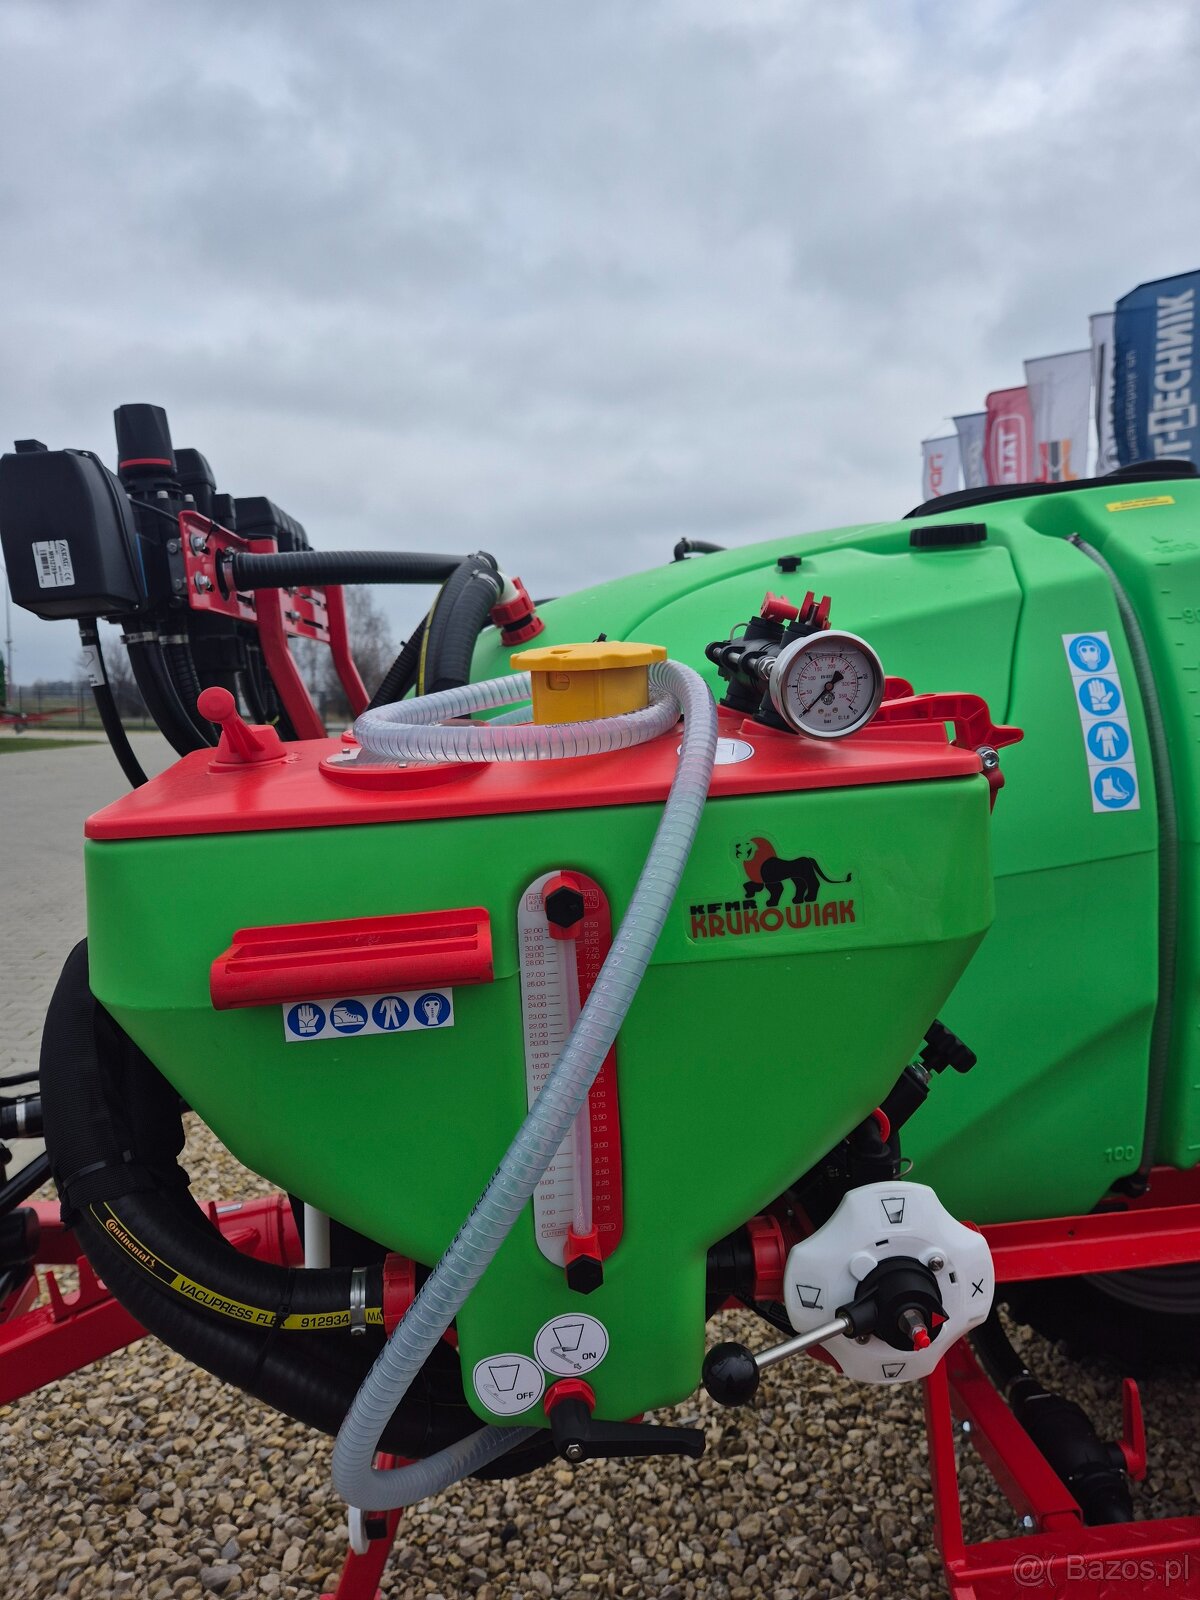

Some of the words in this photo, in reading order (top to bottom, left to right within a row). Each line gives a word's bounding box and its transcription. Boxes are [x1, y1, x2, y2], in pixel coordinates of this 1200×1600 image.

[690, 899, 758, 915] KFMR
[691, 899, 856, 939] KRUKOWIAK
[1104, 1145, 1136, 1163] 100
[105, 1218, 150, 1263] Continental
[179, 1280, 254, 1320] VACUPRESS
[581, 1352, 597, 1360] ON
[516, 1391, 534, 1400] OFF
